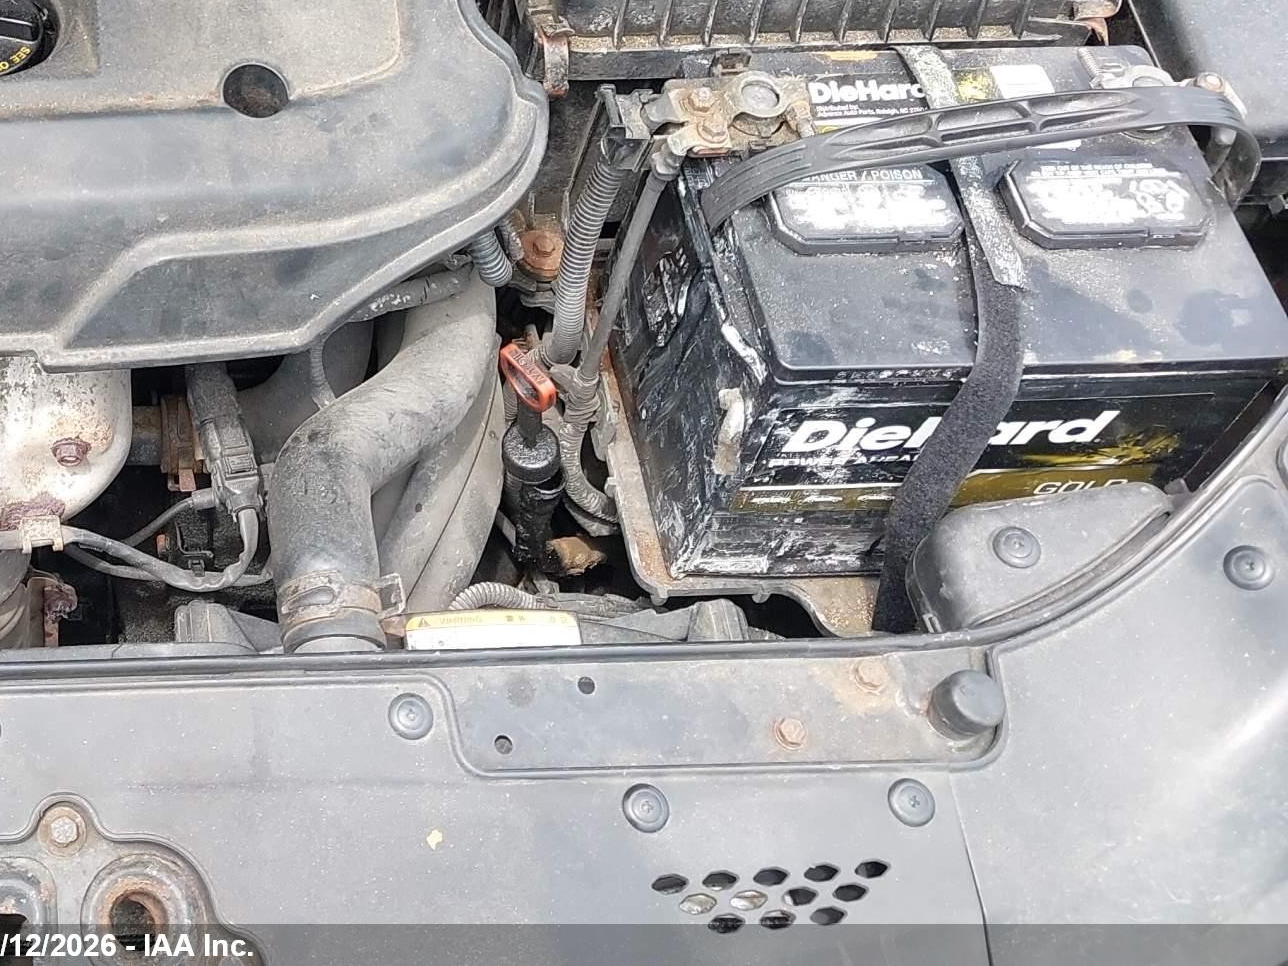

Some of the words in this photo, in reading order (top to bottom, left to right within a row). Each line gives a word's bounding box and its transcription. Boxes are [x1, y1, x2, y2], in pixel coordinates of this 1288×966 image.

[10, 45, 31, 64] SEE
[802, 170, 857, 182] ANGER
[871, 169, 923, 181] POISON
